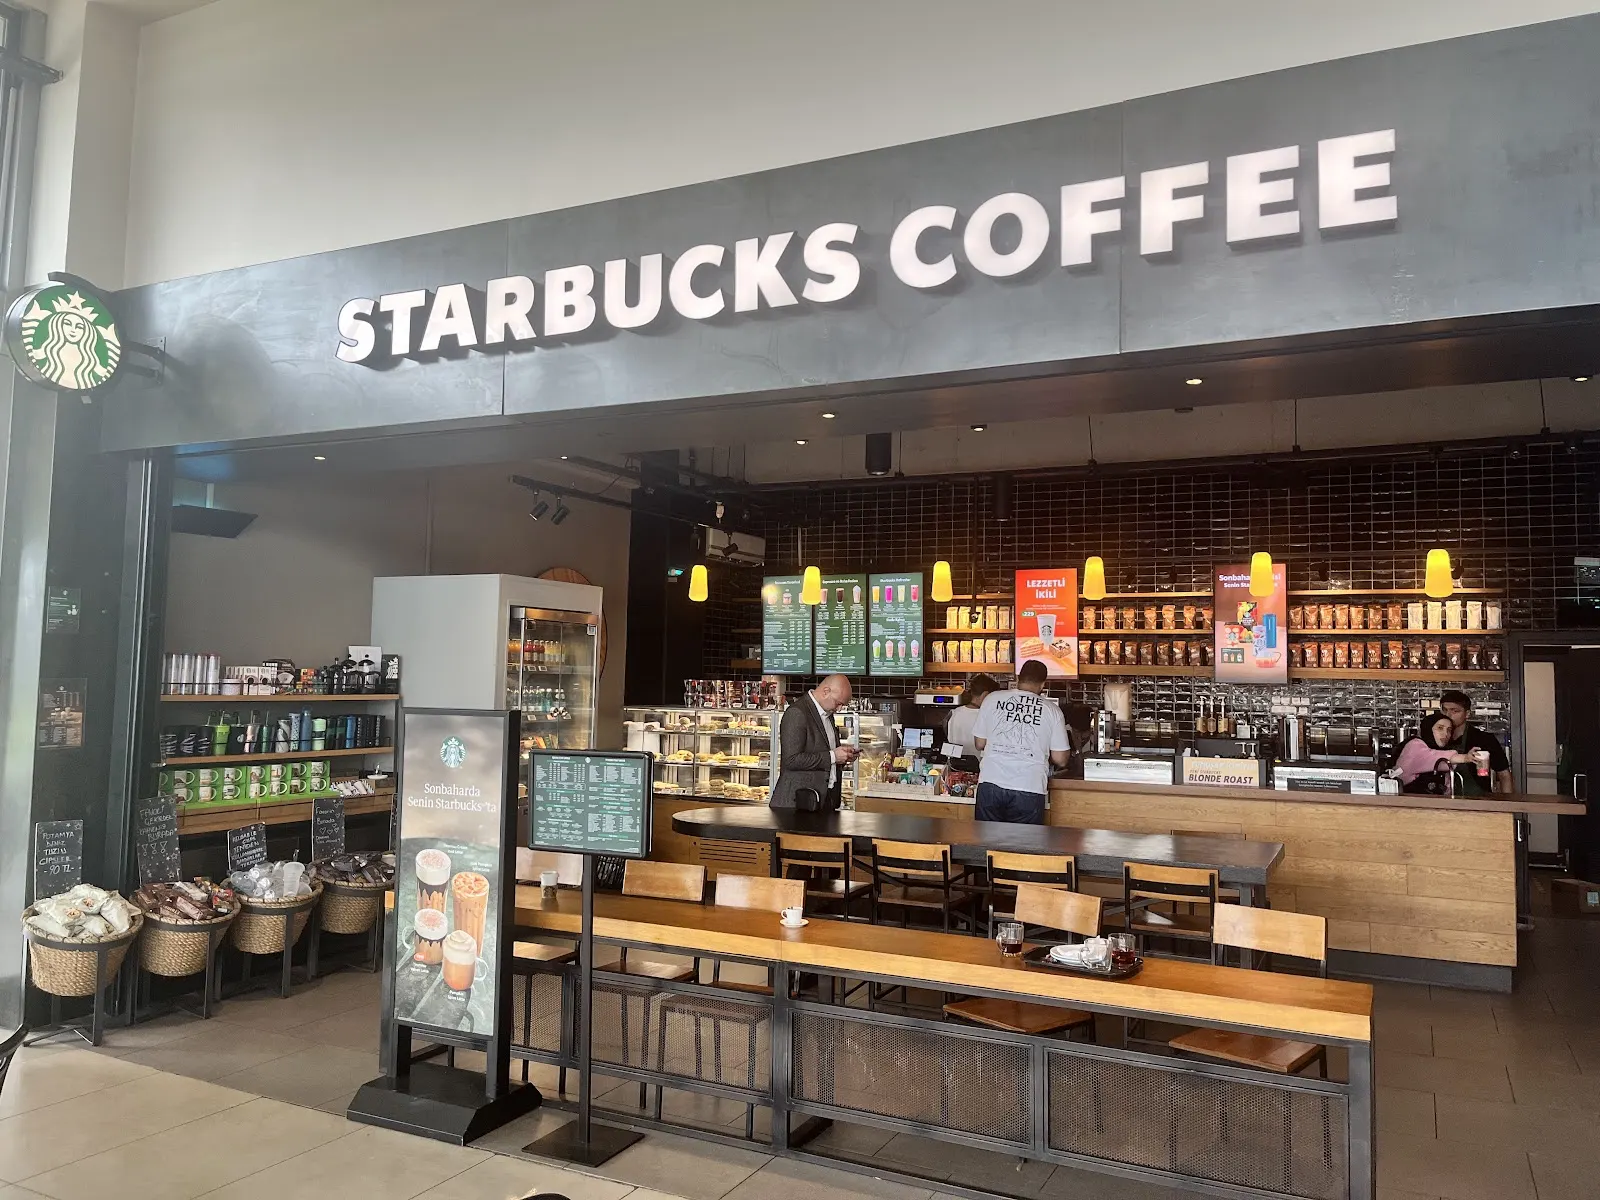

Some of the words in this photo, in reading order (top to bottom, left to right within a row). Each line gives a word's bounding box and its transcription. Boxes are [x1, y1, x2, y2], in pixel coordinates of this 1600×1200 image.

[335, 222, 860, 364] STARBUCKS
[889, 128, 1398, 288] COFFEE
[1026, 577, 1066, 588] LEZZETLİ
[1035, 589, 1057, 599] İKİLİ
[1020, 695, 1043, 706] THE
[996, 700, 1043, 716] NORTH
[1006, 712, 1041, 726] FACE
[1188, 774, 1222, 783] BLONDE
[1223, 776, 1254, 785] ROAST
[424, 783, 481, 797] Sonbaharda
[407, 796, 434, 808] Senin
